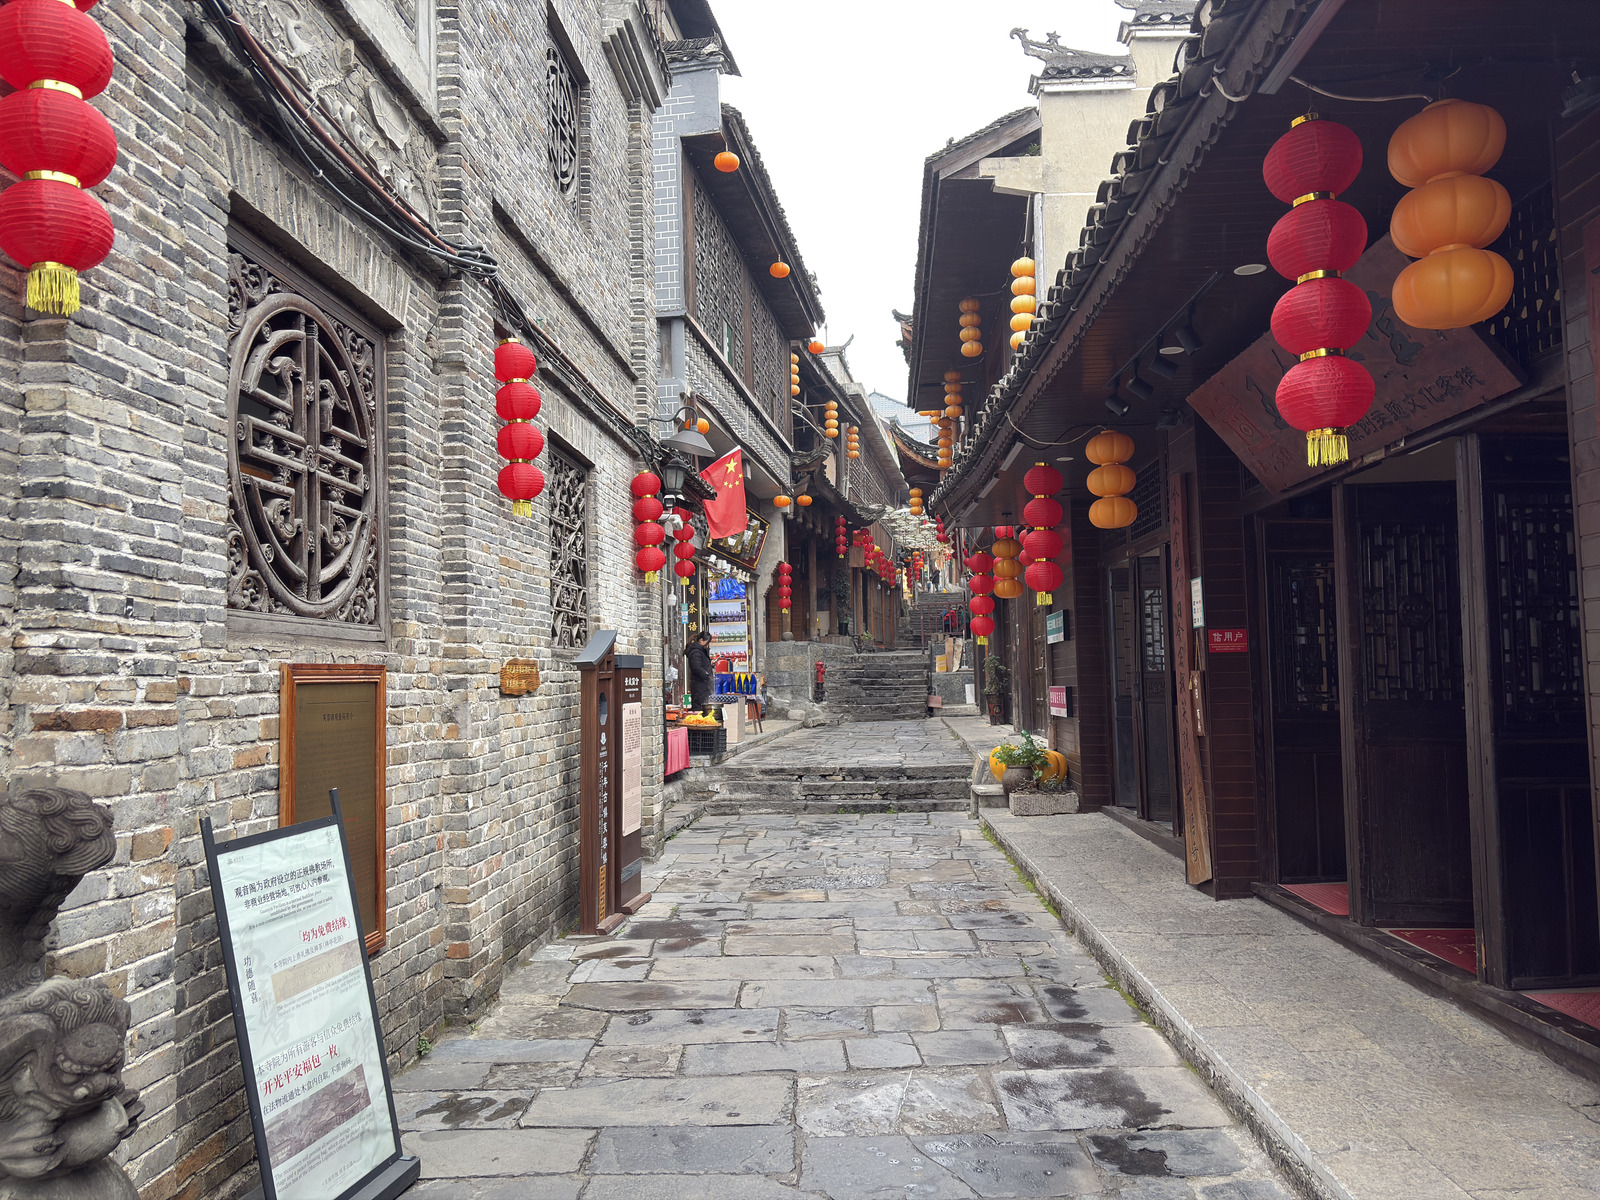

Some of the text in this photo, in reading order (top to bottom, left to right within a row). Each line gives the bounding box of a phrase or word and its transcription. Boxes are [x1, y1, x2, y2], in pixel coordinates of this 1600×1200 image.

[256, 1013, 362, 1076] 本寺院为所有游客与信众免费结缘
